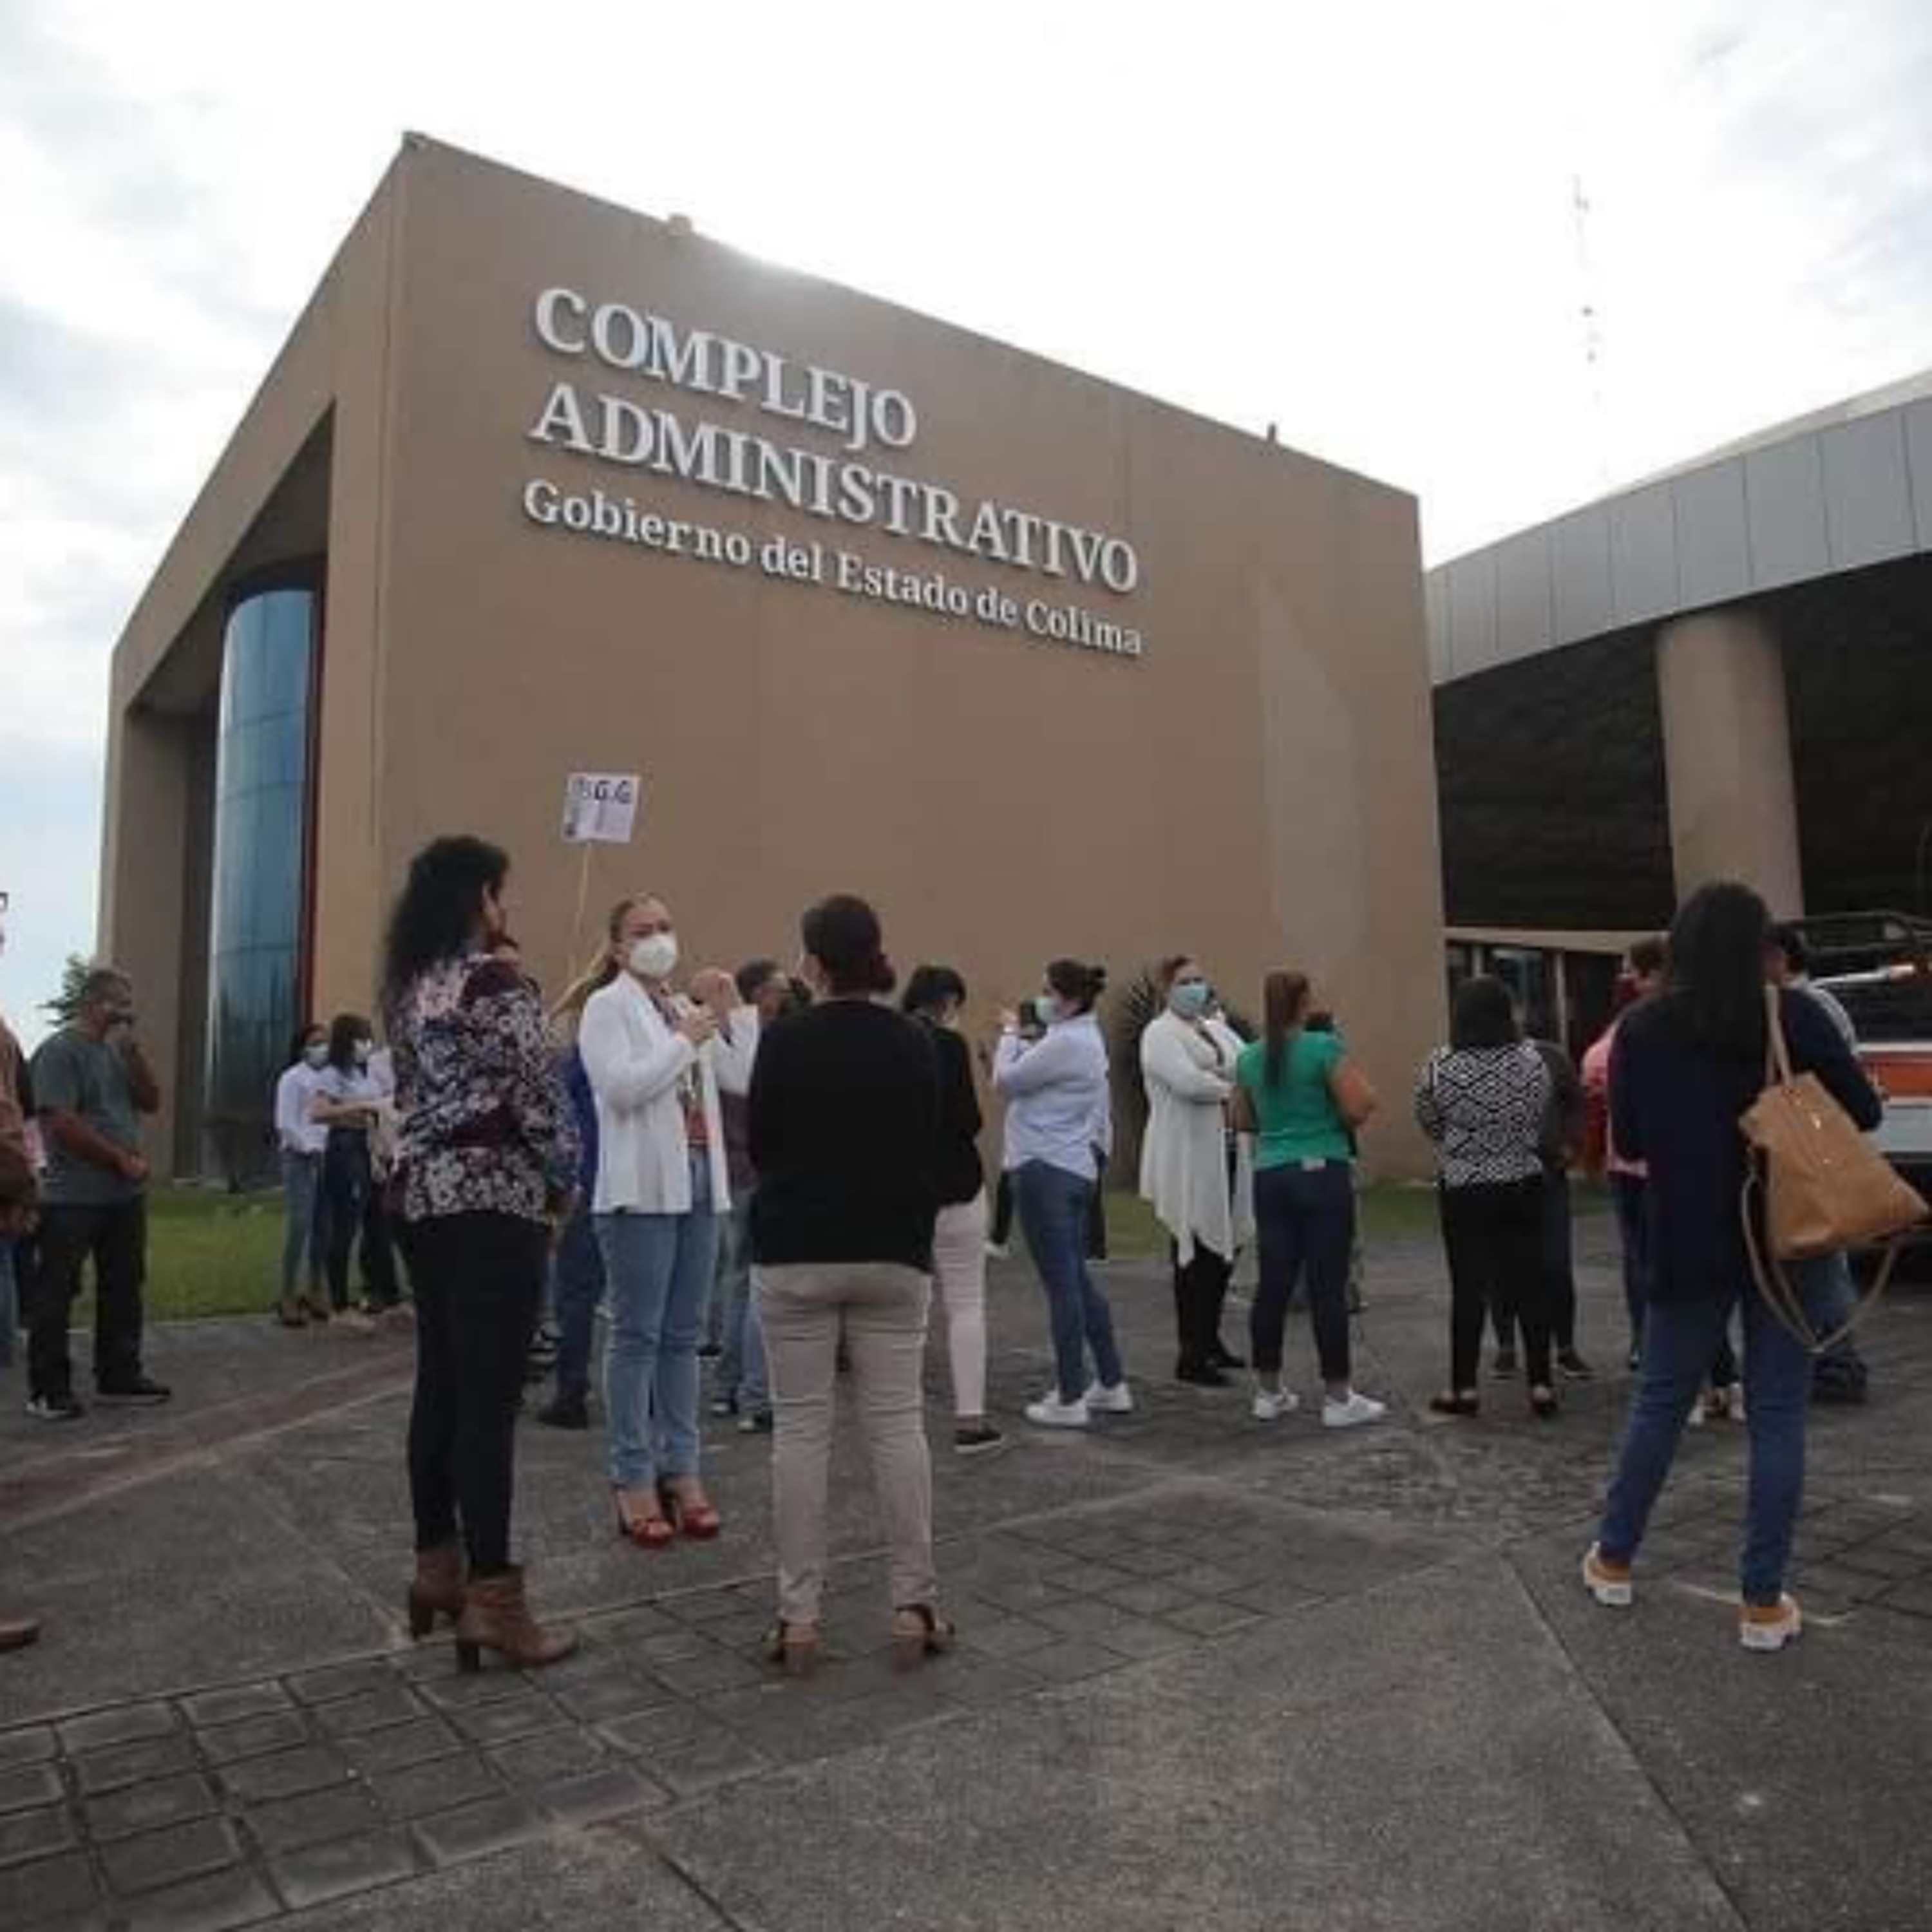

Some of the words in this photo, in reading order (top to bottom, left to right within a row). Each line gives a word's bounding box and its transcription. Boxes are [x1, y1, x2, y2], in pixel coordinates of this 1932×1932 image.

[535, 288, 917, 450] COMPLEJO
[524, 479, 751, 565] Gobierno
[761, 536, 822, 583] del
[837, 553, 969, 616] Estado
[976, 587, 1018, 627] de
[1026, 601, 1142, 656] Colima
[528, 383, 1138, 594] ADMINISTRATIVO
